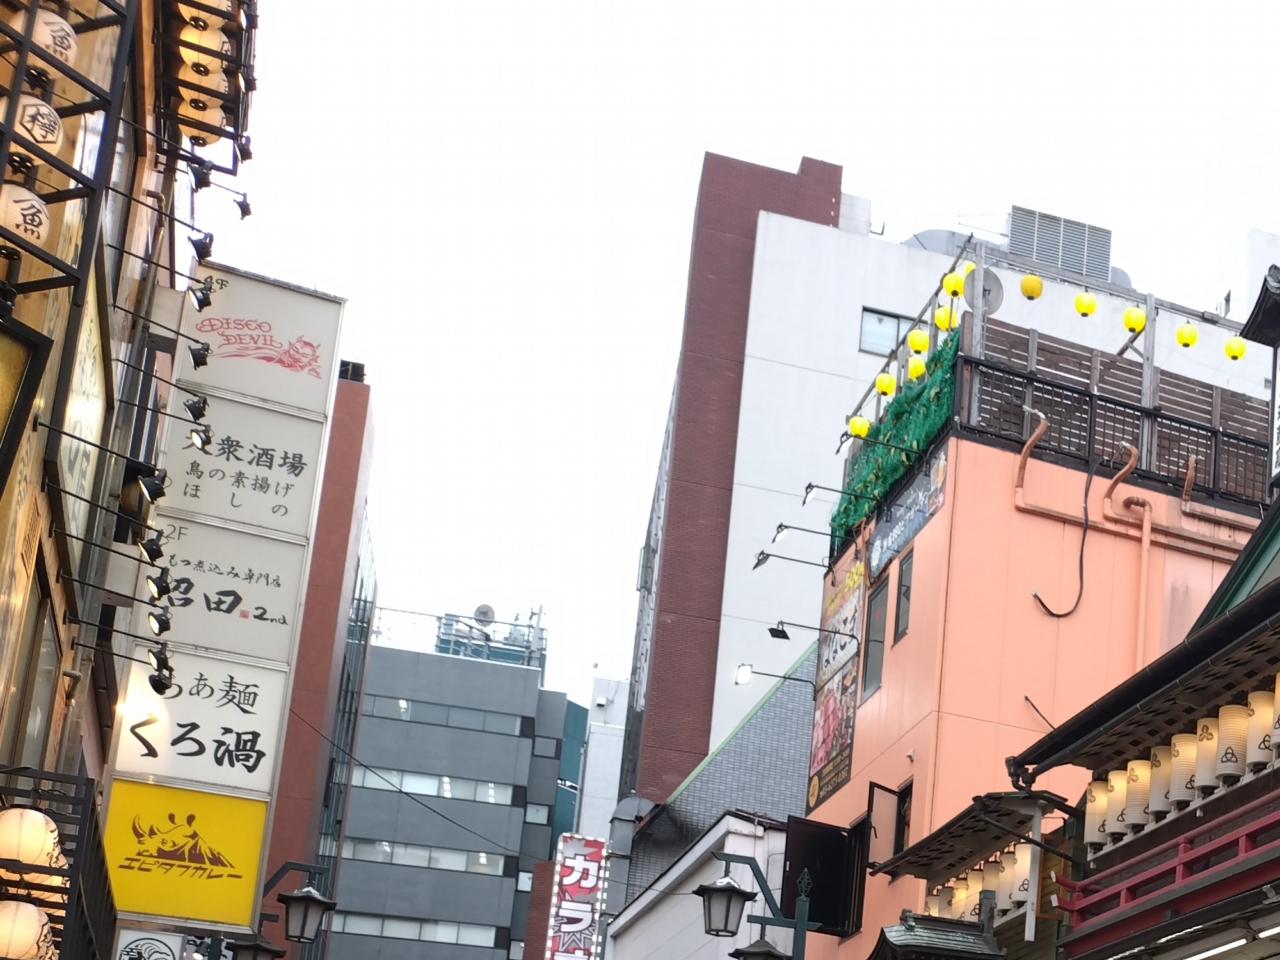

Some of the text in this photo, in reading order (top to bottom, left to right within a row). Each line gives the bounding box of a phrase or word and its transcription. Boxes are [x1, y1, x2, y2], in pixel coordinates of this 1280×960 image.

[195, 316, 273, 334] DISCO
[217, 330, 284, 349] DEVIL
[185, 459, 296, 498] 鳥の素揚げ
[167, 524, 188, 541] 2F
[129, 711, 268, 774] くろ渦
[117, 856, 243, 881] エピタフカレー
